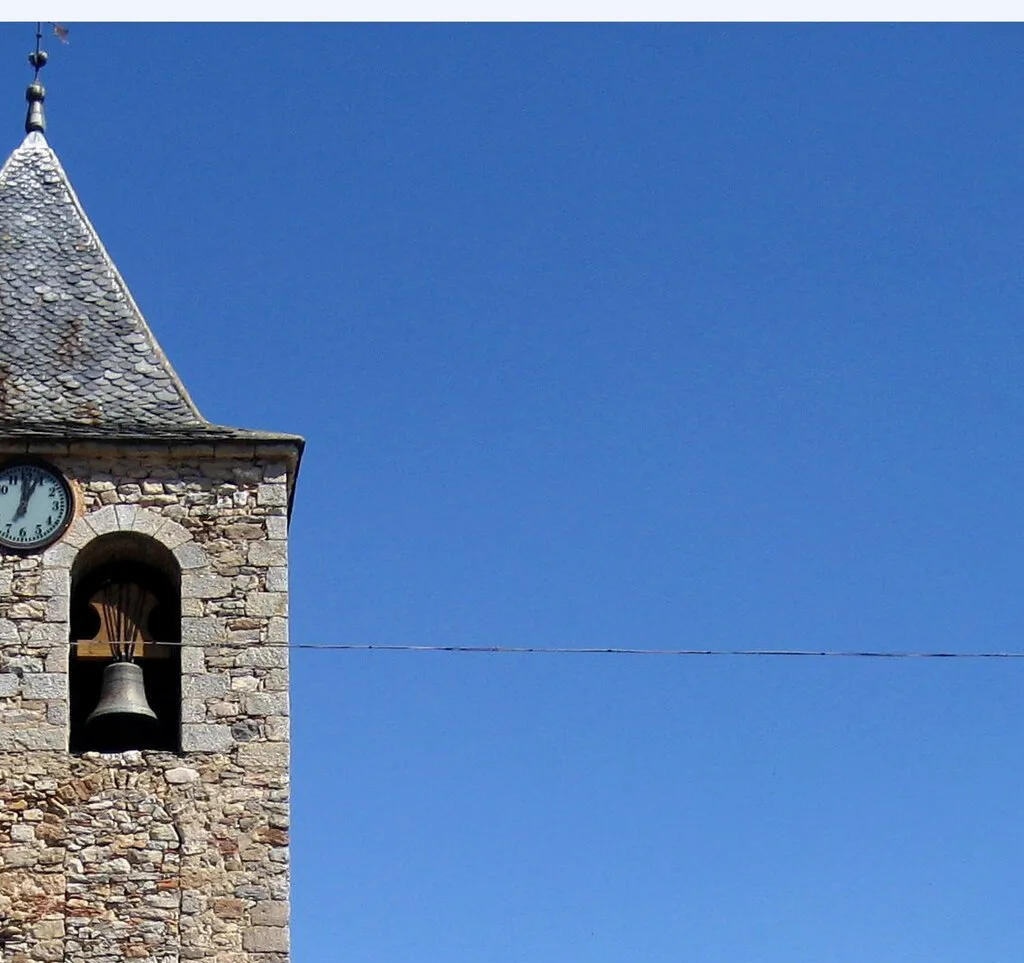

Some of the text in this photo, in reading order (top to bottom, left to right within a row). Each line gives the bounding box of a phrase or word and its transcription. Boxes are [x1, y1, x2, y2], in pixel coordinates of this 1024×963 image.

[8, 476, 18, 485] 11
[39, 477, 44, 486] 1
[48, 487, 56, 497] 2
[52, 501, 59, 511] 3
[46, 516, 52, 525] 4
[6, 524, 12, 533] 7
[20, 527, 26, 536] 6
[35, 524, 42, 534] 5
